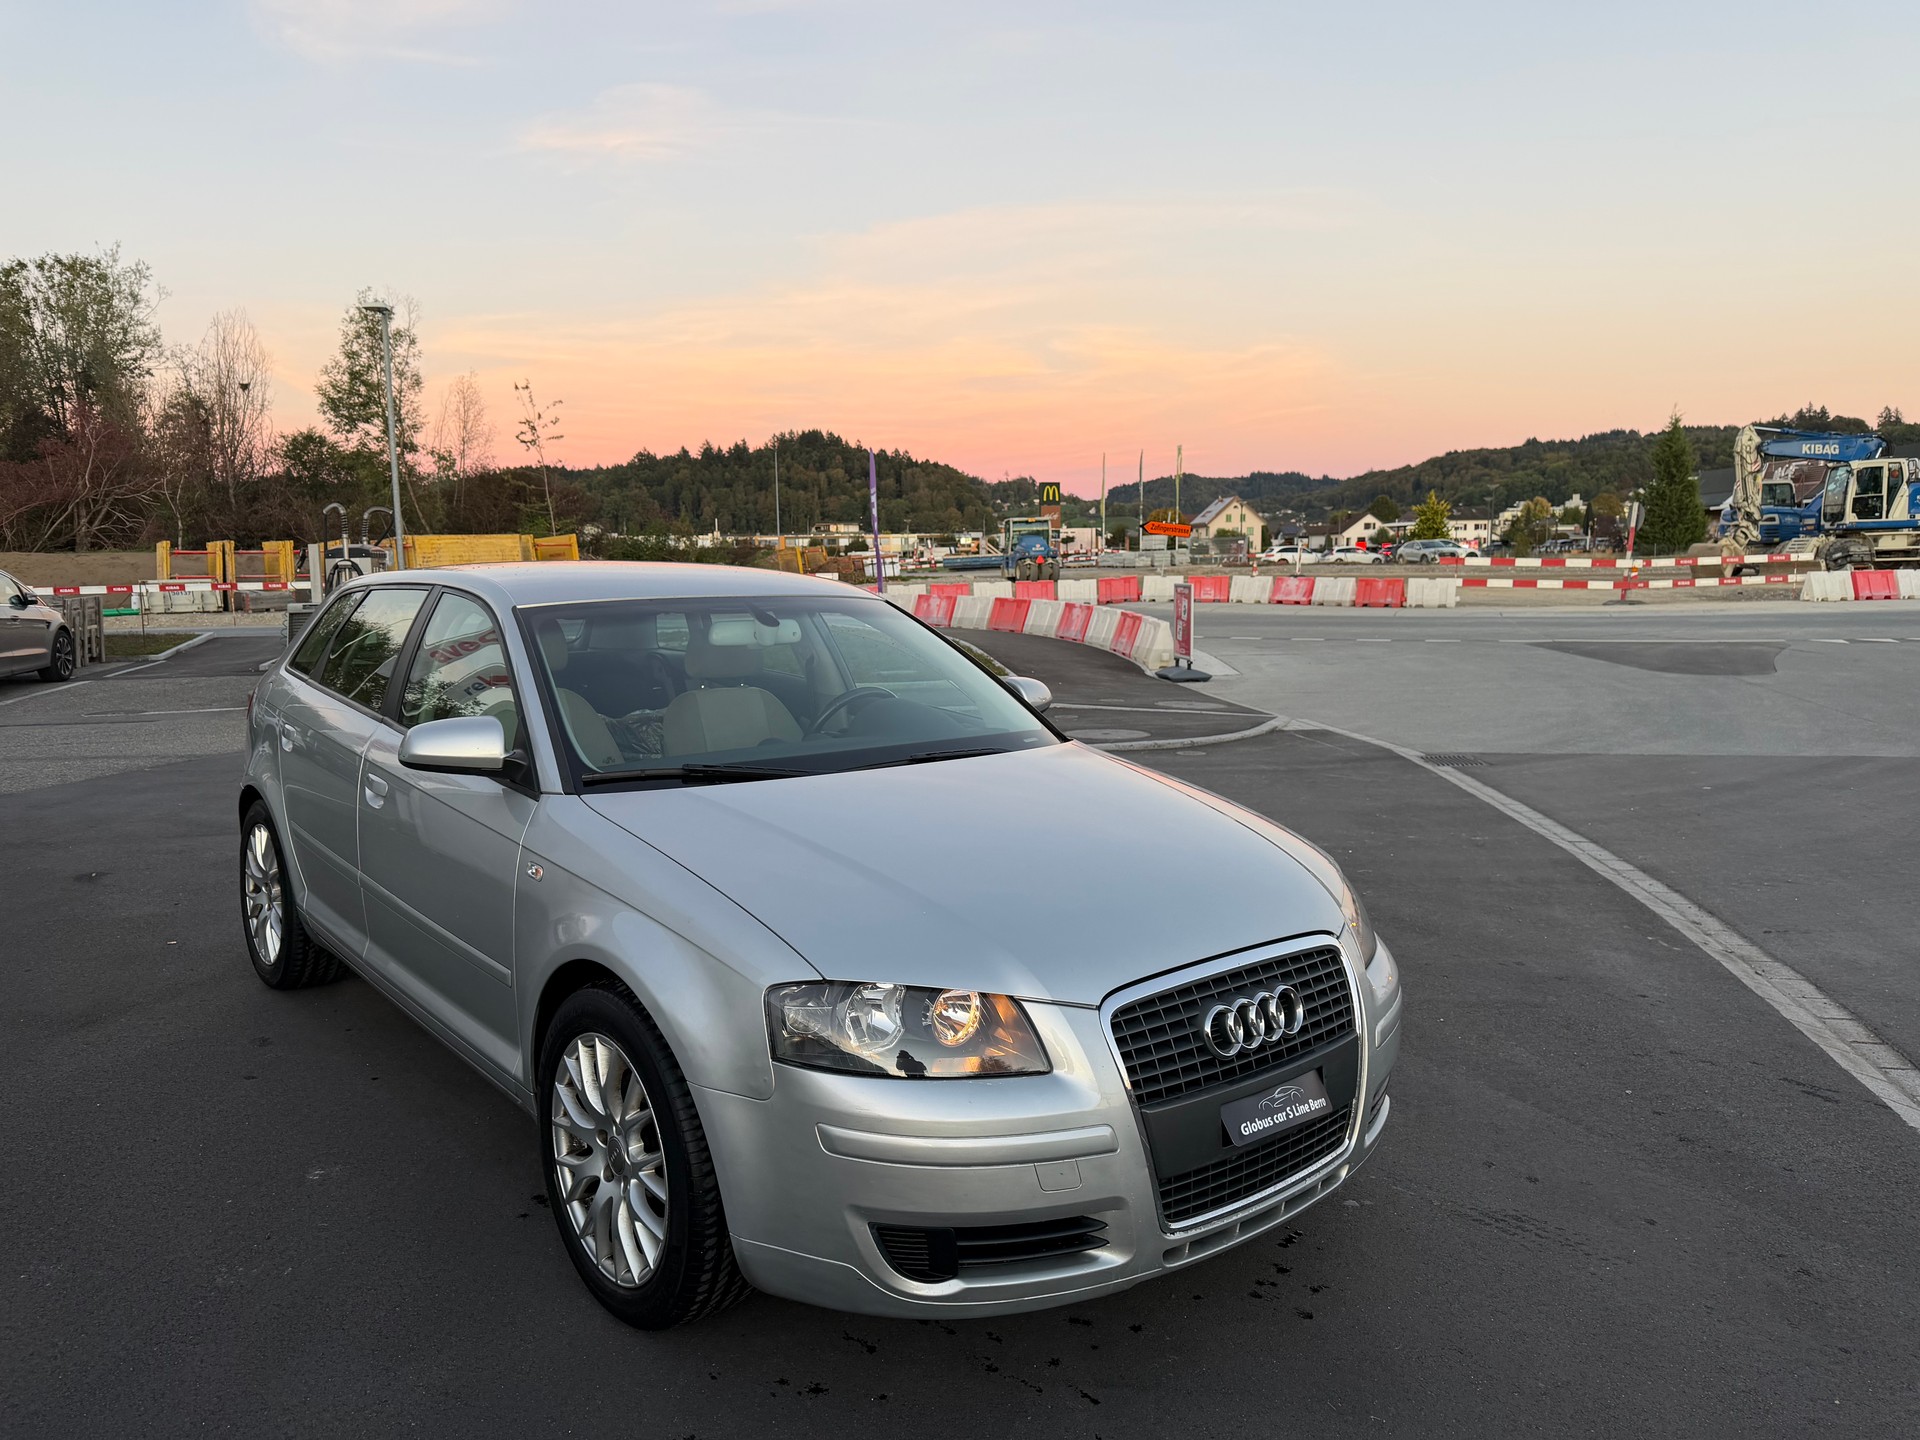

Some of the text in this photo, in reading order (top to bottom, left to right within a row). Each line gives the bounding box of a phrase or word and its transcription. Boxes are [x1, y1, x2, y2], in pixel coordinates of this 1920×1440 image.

[1801, 443, 1840, 455] KIBAG
[1150, 523, 1190, 535] Zofingerstrasse
[1240, 1115, 1274, 1136] Globus
[1273, 1111, 1287, 1124] car
[1286, 1107, 1294, 1119] S
[1292, 1102, 1311, 1117] Line
